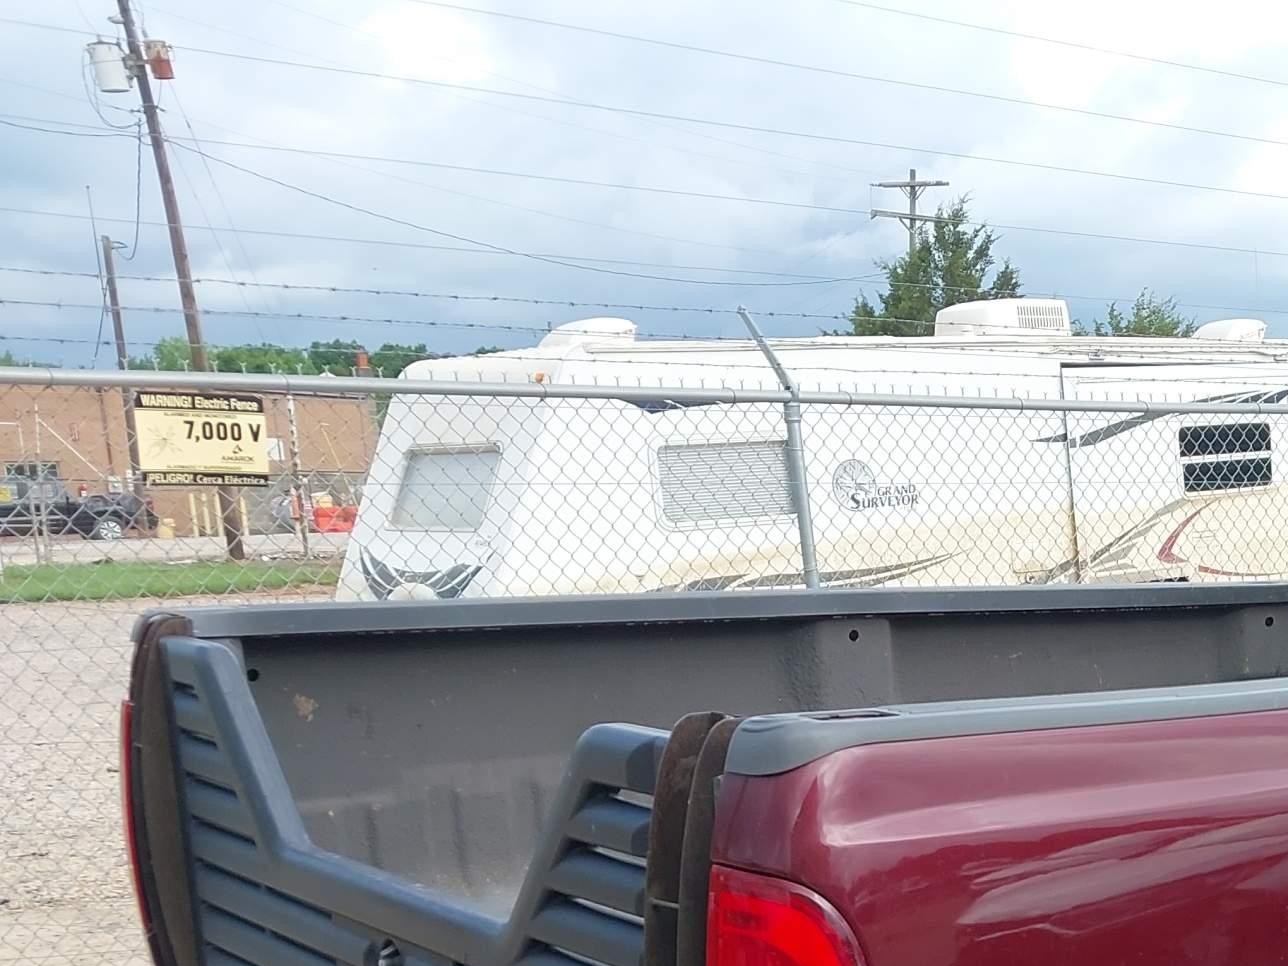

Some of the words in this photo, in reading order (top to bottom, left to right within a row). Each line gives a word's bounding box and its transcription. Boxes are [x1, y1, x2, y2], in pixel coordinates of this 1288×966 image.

[140, 394, 193, 408] WARNING!
[194, 396, 230, 410] Electric
[230, 398, 259, 411] Fence
[183, 420, 242, 443] 7,000
[248, 423, 261, 442] V
[196, 474, 223, 484] Cerca
[877, 484, 916, 496] GRAND
[850, 492, 919, 509] SURVEYOR
